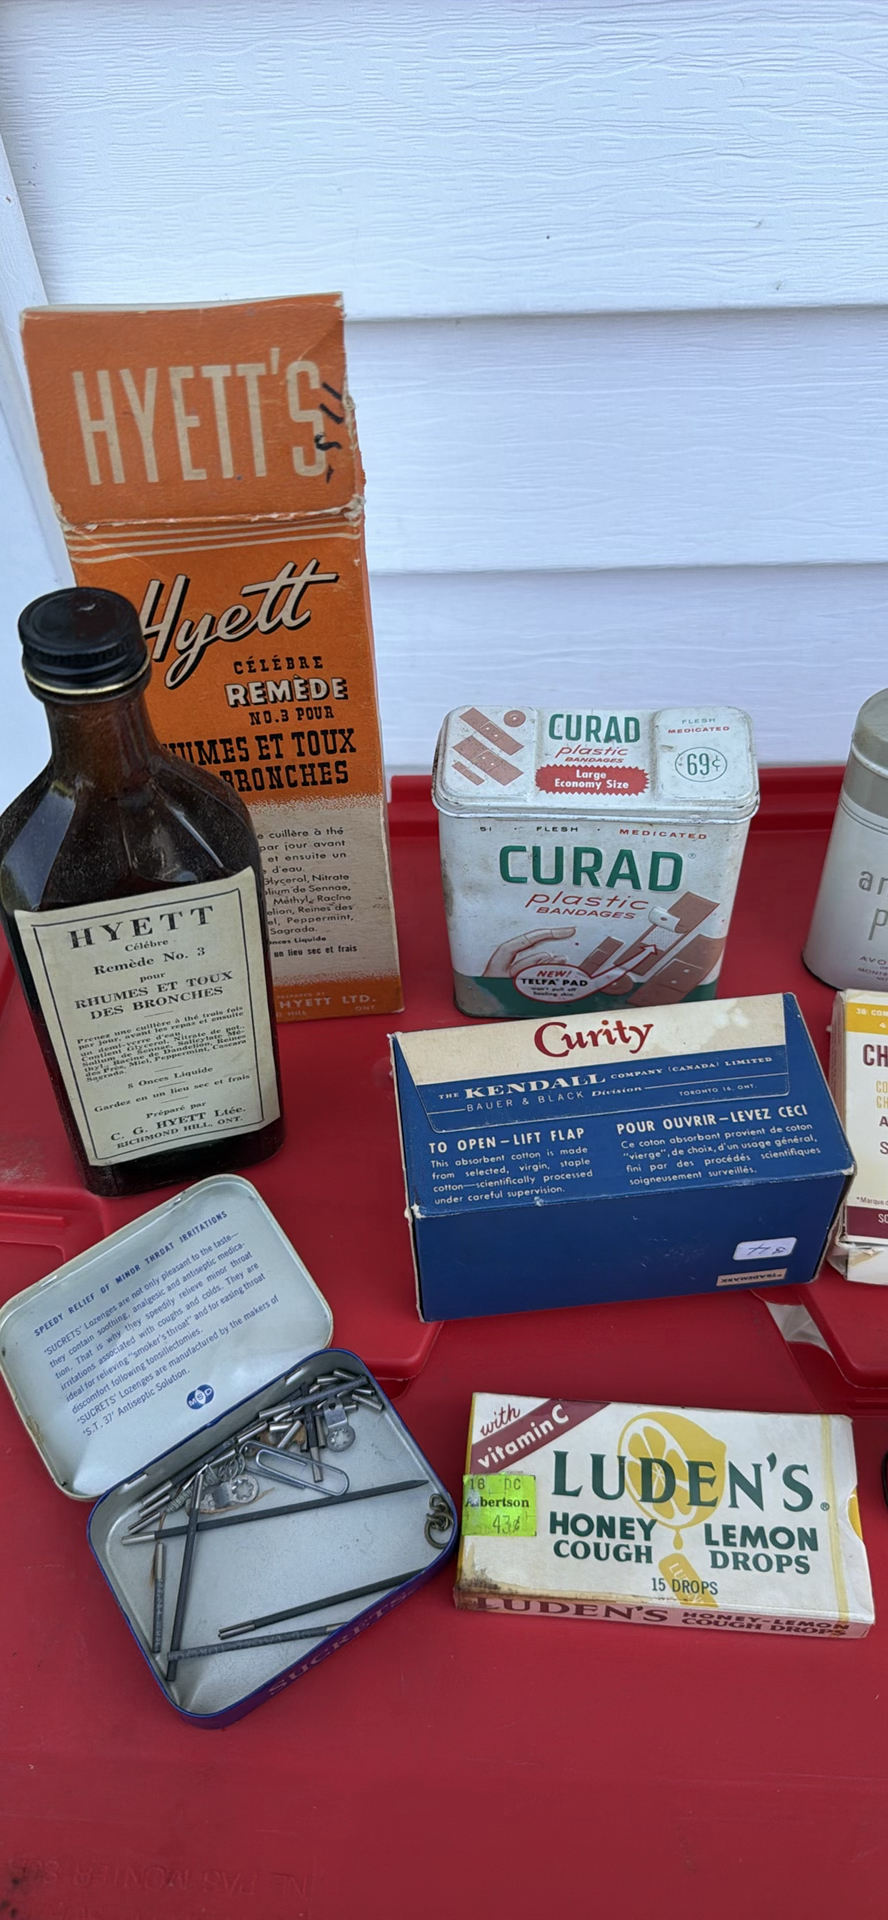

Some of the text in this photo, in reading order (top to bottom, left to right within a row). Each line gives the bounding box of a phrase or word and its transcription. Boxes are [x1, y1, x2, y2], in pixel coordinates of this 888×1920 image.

[71, 347, 328, 486] HYETT'S
[138, 558, 340, 690] Hyett
[233, 655, 324, 675] CÉLÉBRE
[225, 674, 348, 707] REMÈDE
[296, 705, 335, 721] POUR
[548, 713, 641, 744] CURAD
[667, 726, 730, 734] MEDICATED
[254, 733, 284, 760] ET
[291, 728, 356, 757] TOUX
[554, 744, 628, 759] plastic
[220, 760, 349, 793] BRONCHES
[576, 769, 607, 781] Large
[687, 752, 721, 776] 69¢
[554, 778, 629, 790] Economy Size
[268, 826, 344, 839] cuillère à thé
[619, 828, 707, 840] MEDICATED
[499, 845, 683, 892] CURAD
[524, 890, 649, 910] plastic
[536, 906, 636, 920] BANDAGES
[68, 905, 213, 949] HYETT
[93, 947, 205, 975] Remède No. 3
[139, 972, 166, 983] pour
[536, 970, 572, 978] NEW!
[562, 979, 588, 987] PAD
[74, 972, 233, 1009] RHUMES ET TOUX
[90, 986, 223, 1020] DES BRONCHES
[279, 994, 376, 1009] HYETT LTD.
[534, 1018, 653, 1058] Curity
[138, 1076, 169, 1086] Onces
[174, 1066, 213, 1079] Liquide
[438, 1057, 772, 1100] THE KENDALL COMPANY (CANADA) LIMITED
[94, 1100, 131, 1112] Gardez
[170, 1086, 189, 1094] lieu
[228, 1073, 250, 1083] frais
[466, 1087, 642, 1112] BAUER & BLACK Division
[679, 1087, 719, 1096] TORONTO
[146, 1102, 206, 1119] Préparé par
[616, 1120, 656, 1135] POUR
[778, 1104, 808, 1118] CECI
[110, 1132, 125, 1141] C.
[132, 1126, 148, 1135] G.
[156, 1112, 206, 1129] HYETT
[117, 1128, 179, 1149] RICHMOND
[217, 1115, 243, 1125] ONT.
[621, 1124, 813, 1149] Ce coton absorbant provient de coton
[428, 1141, 447, 1154] TO
[550, 1127, 584, 1142] FLAP
[671, 1148, 684, 1156] de
[687, 1144, 717, 1155] choix,
[717, 1142, 739, 1151] d'un
[741, 1140, 771, 1149] usage
[430, 1159, 449, 1168] This
[455, 1154, 505, 1166] absorbent
[511, 1152, 541, 1161] cotton
[560, 1146, 588, 1155] made
[432, 1157, 590, 1180] from selected, virgin, staple
[626, 1147, 821, 1173] fini par des procédés scientifiques
[543, 1169, 593, 1183] processed
[629, 1165, 757, 1186] soigneusement surveillés.
[434, 1185, 565, 1205] under careful supervision.
[34, 1211, 227, 1337] SPEEDY RELIEF OF MINOR THROAT IRRITATIONS
[117, 1388, 156, 1416] Antiseptic
[155, 1368, 190, 1392] Solution.
[479, 1403, 521, 1437] with
[477, 1403, 570, 1468] vitamin C
[551, 1450, 814, 1513] LUDEN'S
[549, 1511, 819, 1552] HONEY LEMON
[553, 1539, 811, 1575] COUGH DROPS
[652, 1577, 719, 1596] 15 DROPS
[476, 1597, 849, 1630] LUDEN'S HONEY-LEMON
[681, 1618, 847, 1637] COUGH DROPS
